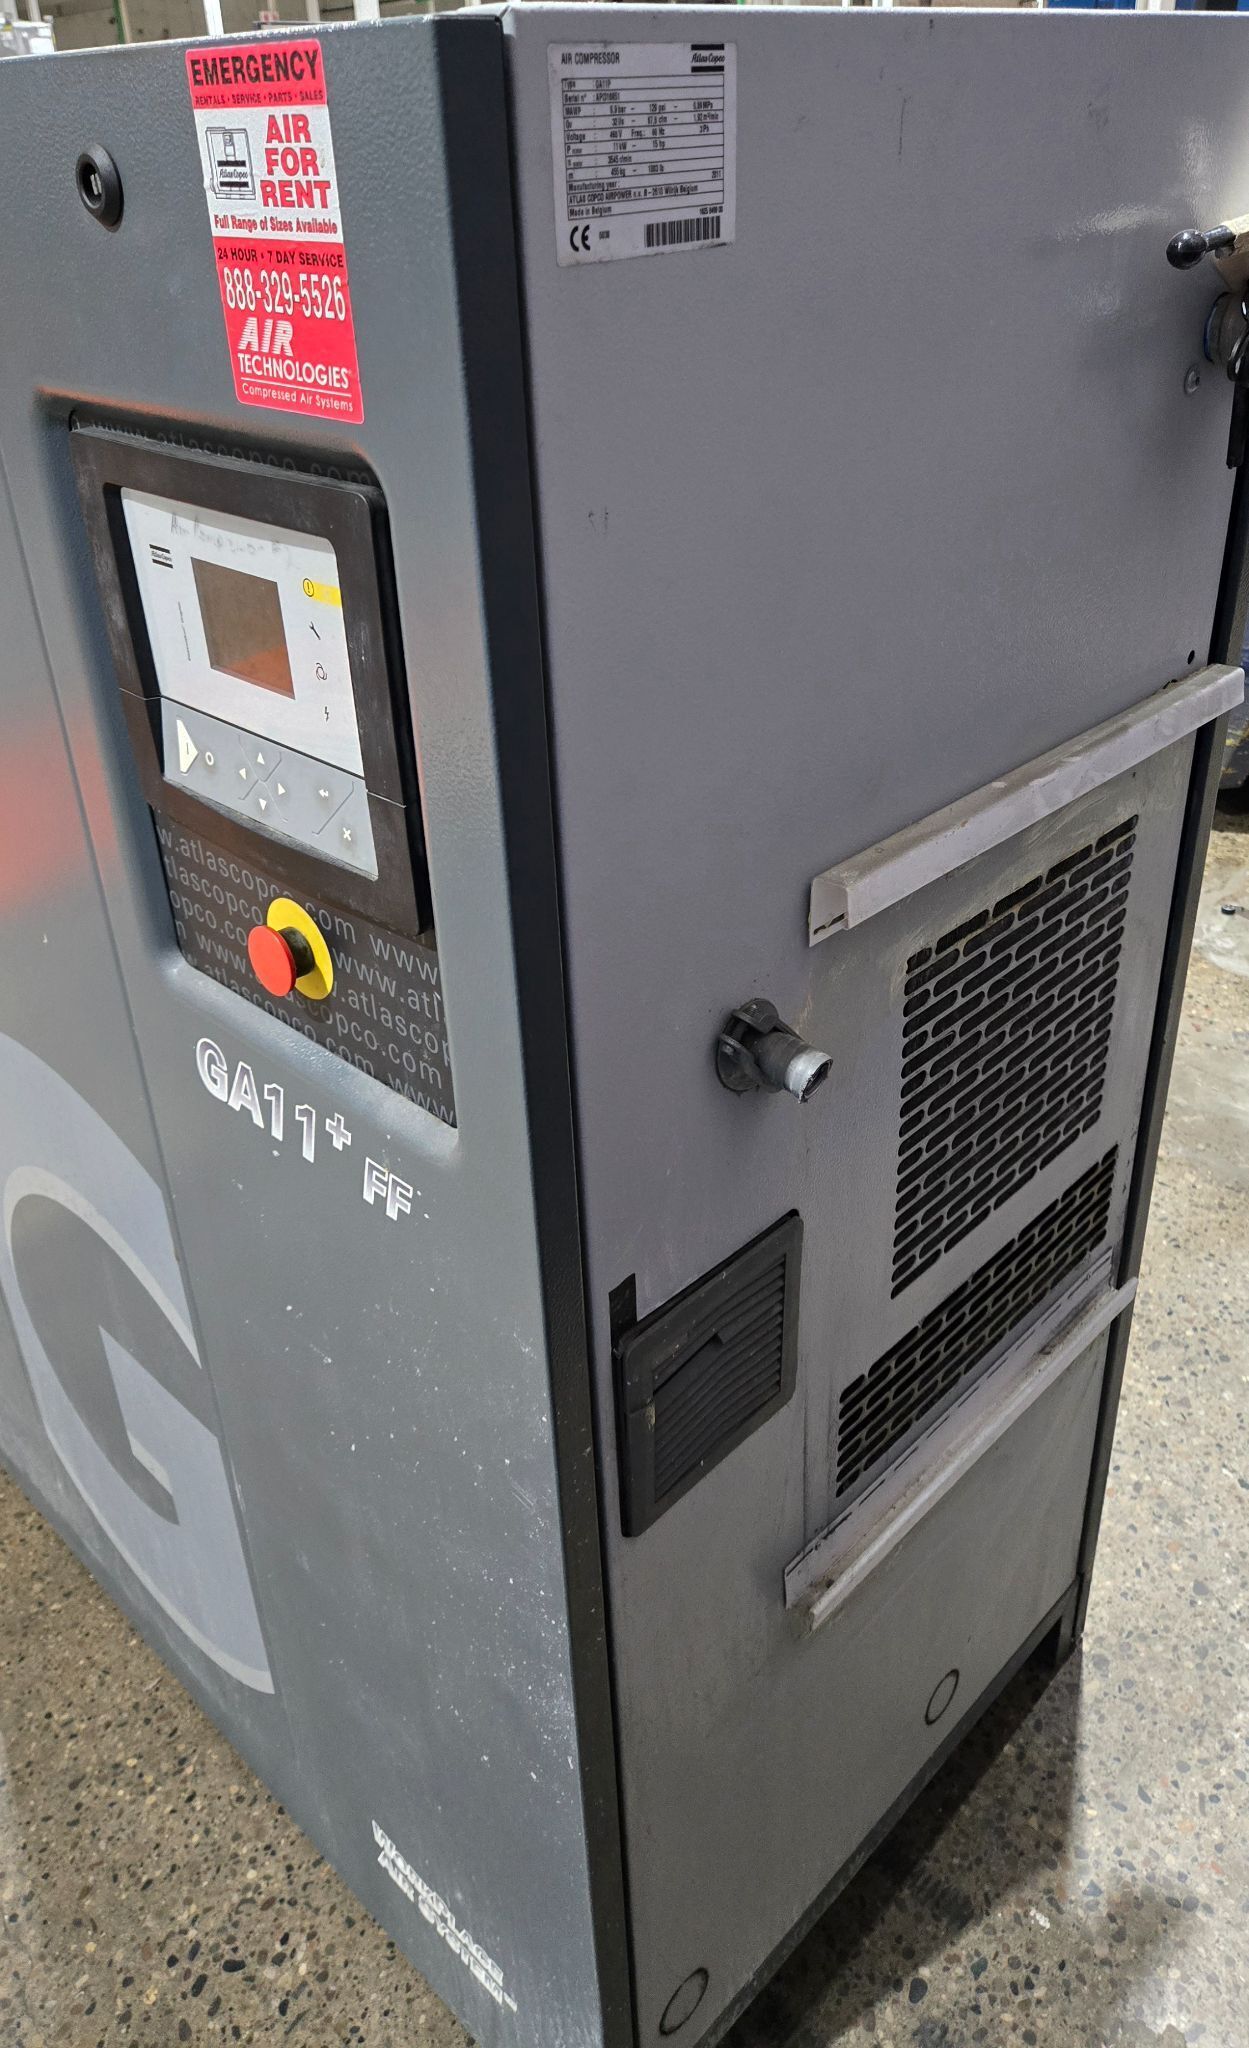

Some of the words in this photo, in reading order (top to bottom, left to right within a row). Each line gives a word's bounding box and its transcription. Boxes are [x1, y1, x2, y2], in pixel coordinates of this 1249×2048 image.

[190, 49, 319, 86] EMERGENCY
[561, 52, 573, 65] AIR
[574, 51, 620, 64] COMPRESSOR
[195, 95, 226, 106] RENTALS
[231, 92, 262, 104] SERVICE
[268, 91, 293, 103] PARTS
[299, 89, 324, 101] SALES
[266, 114, 312, 144] AIR
[264, 147, 320, 177] FOR
[260, 180, 331, 209] RENT
[214, 214, 229, 229] Full
[230, 214, 258, 233] Range
[260, 217, 269, 231] of
[269, 216, 294, 232] Sizes
[295, 217, 338, 235] Available
[217, 247, 228, 260] 24
[230, 247, 258, 262] HOUR
[267, 250, 273, 263] 7
[275, 251, 296, 265] DAY
[298, 252, 344, 268] SERVICE
[223, 266, 346, 321] 888-329-5526
[237, 316, 294, 357] AIR
[237, 352, 349, 389] TECHNOLOGIES
[242, 382, 297, 402] Compressed
[300, 391, 313, 405] Air
[315, 394, 353, 412] Systems
[195, 1037, 352, 1164] GA11+
[362, 1156, 413, 1221] FF
